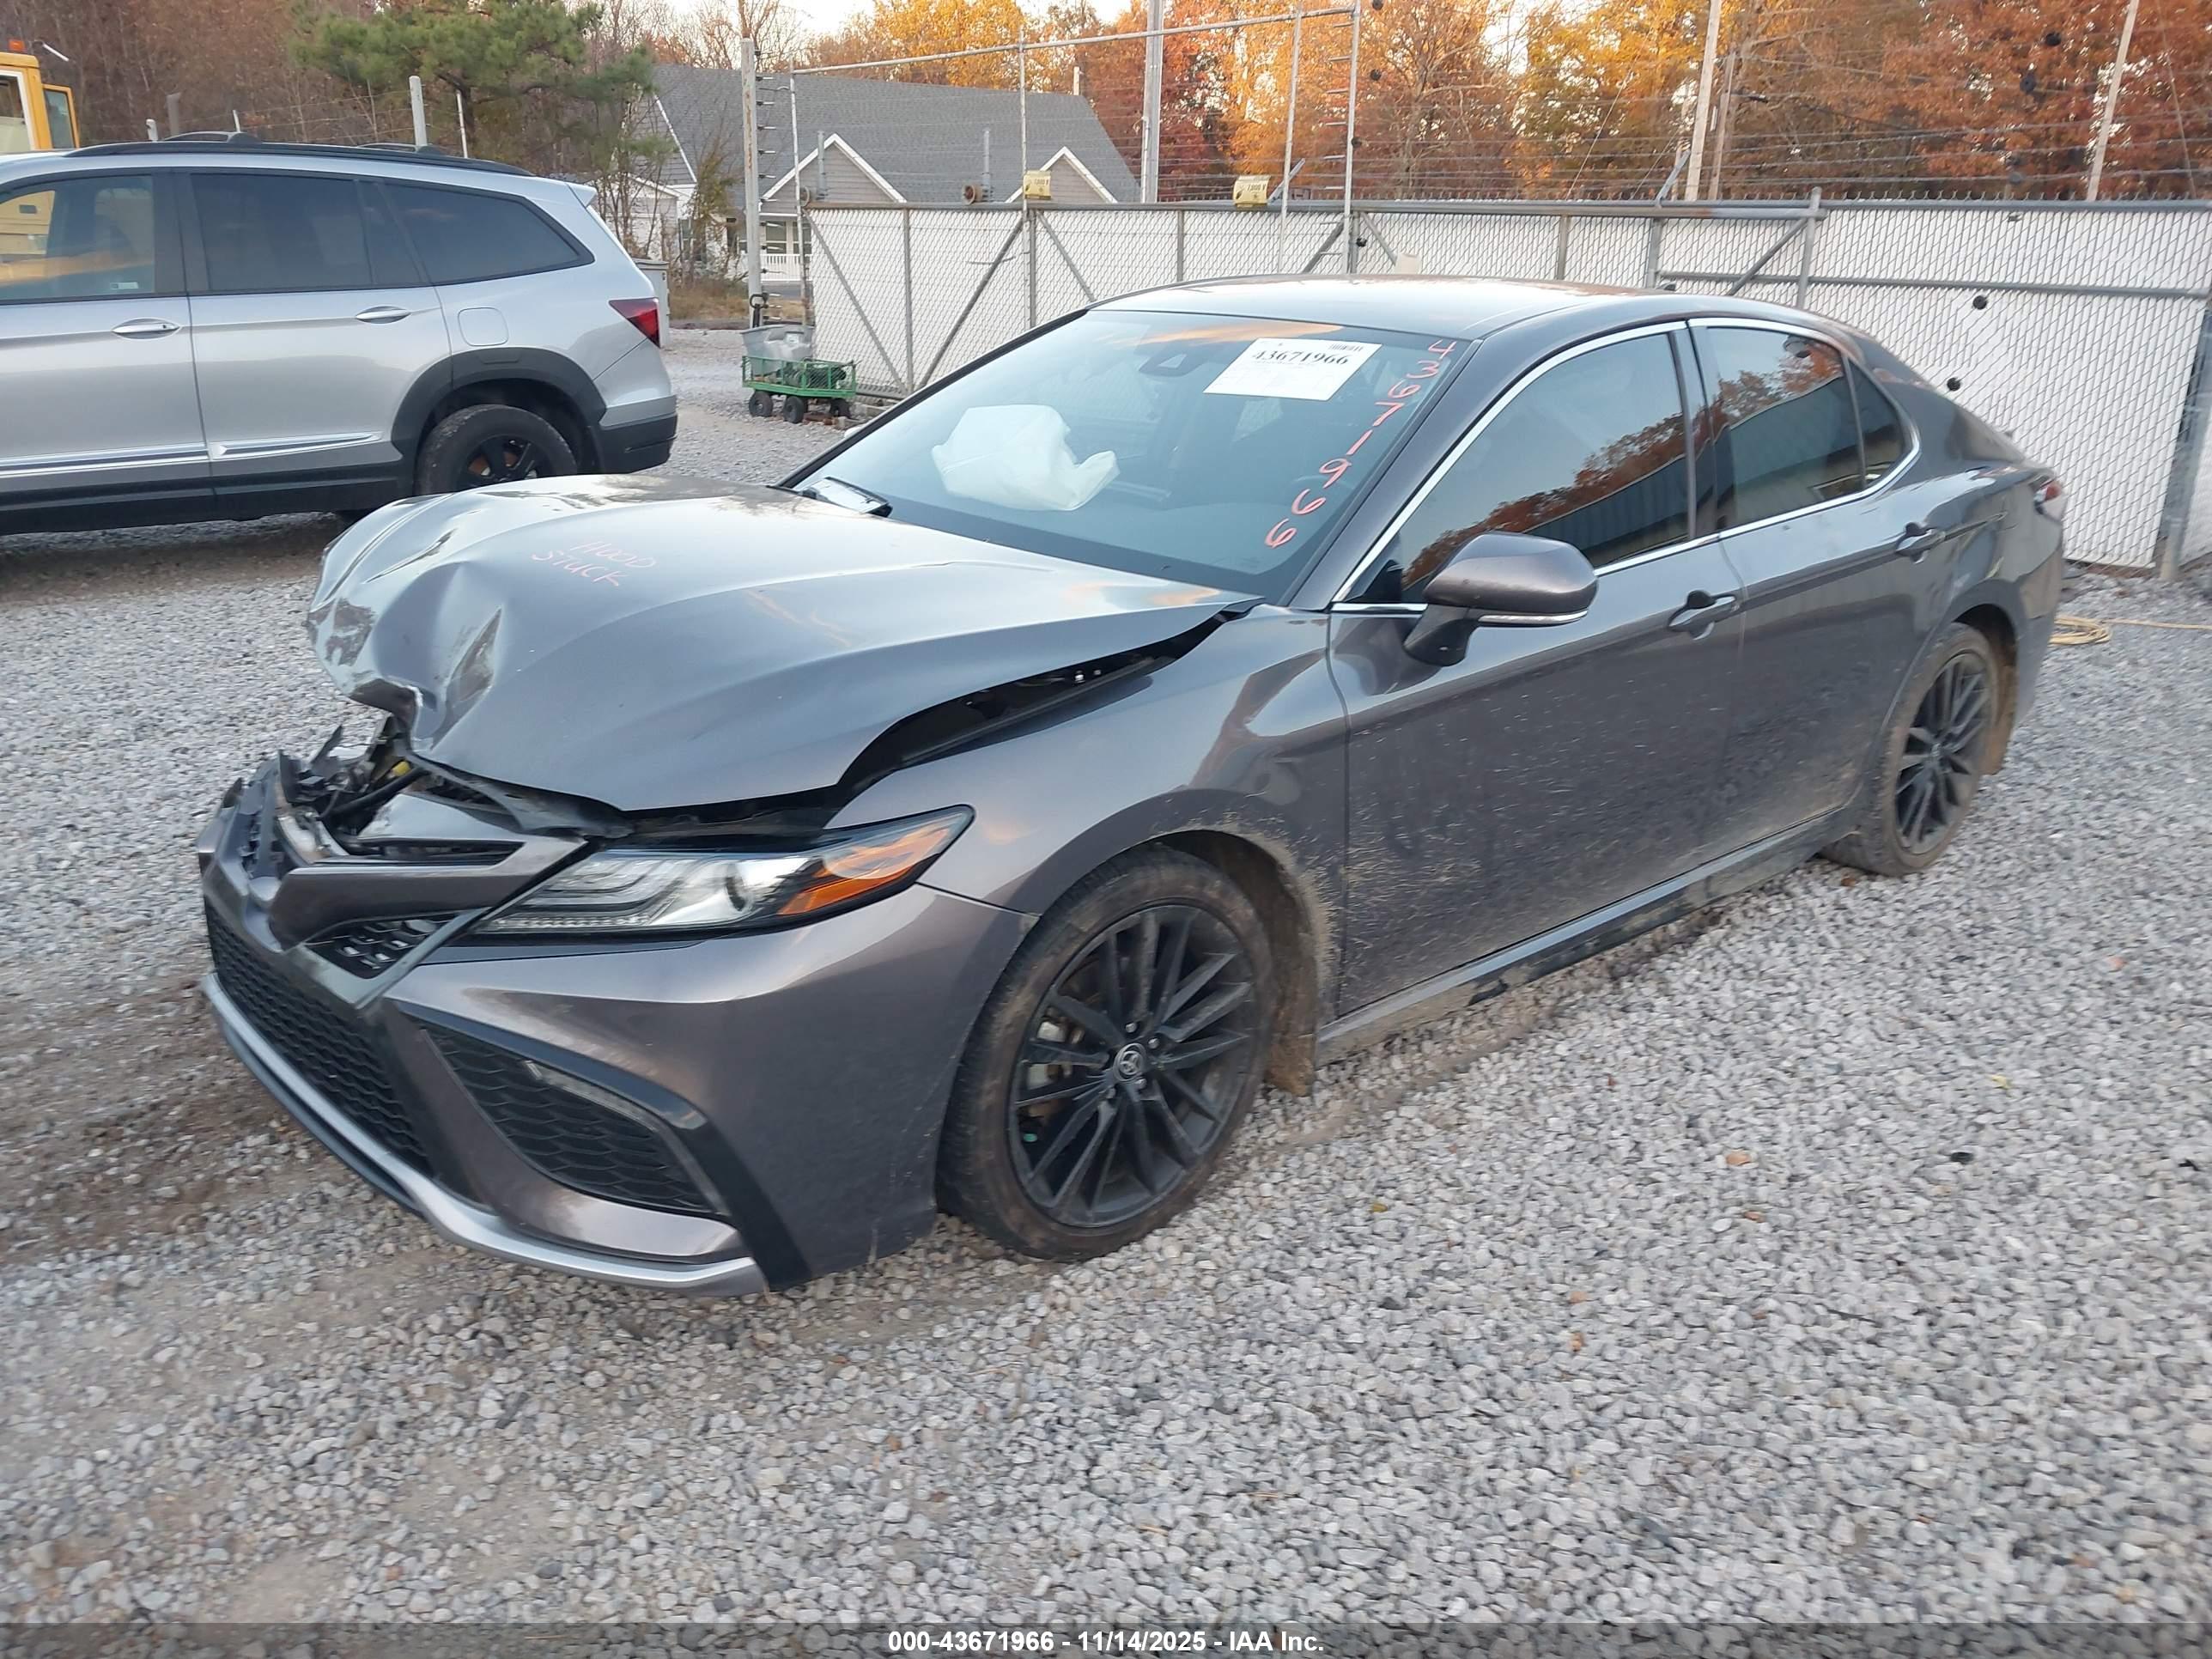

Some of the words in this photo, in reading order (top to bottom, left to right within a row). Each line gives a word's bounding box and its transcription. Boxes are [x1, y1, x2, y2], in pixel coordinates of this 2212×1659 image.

[1252, 349, 1349, 365] 43671966
[1264, 339, 1457, 549] 43671966
[531, 550, 629, 586] STUCK
